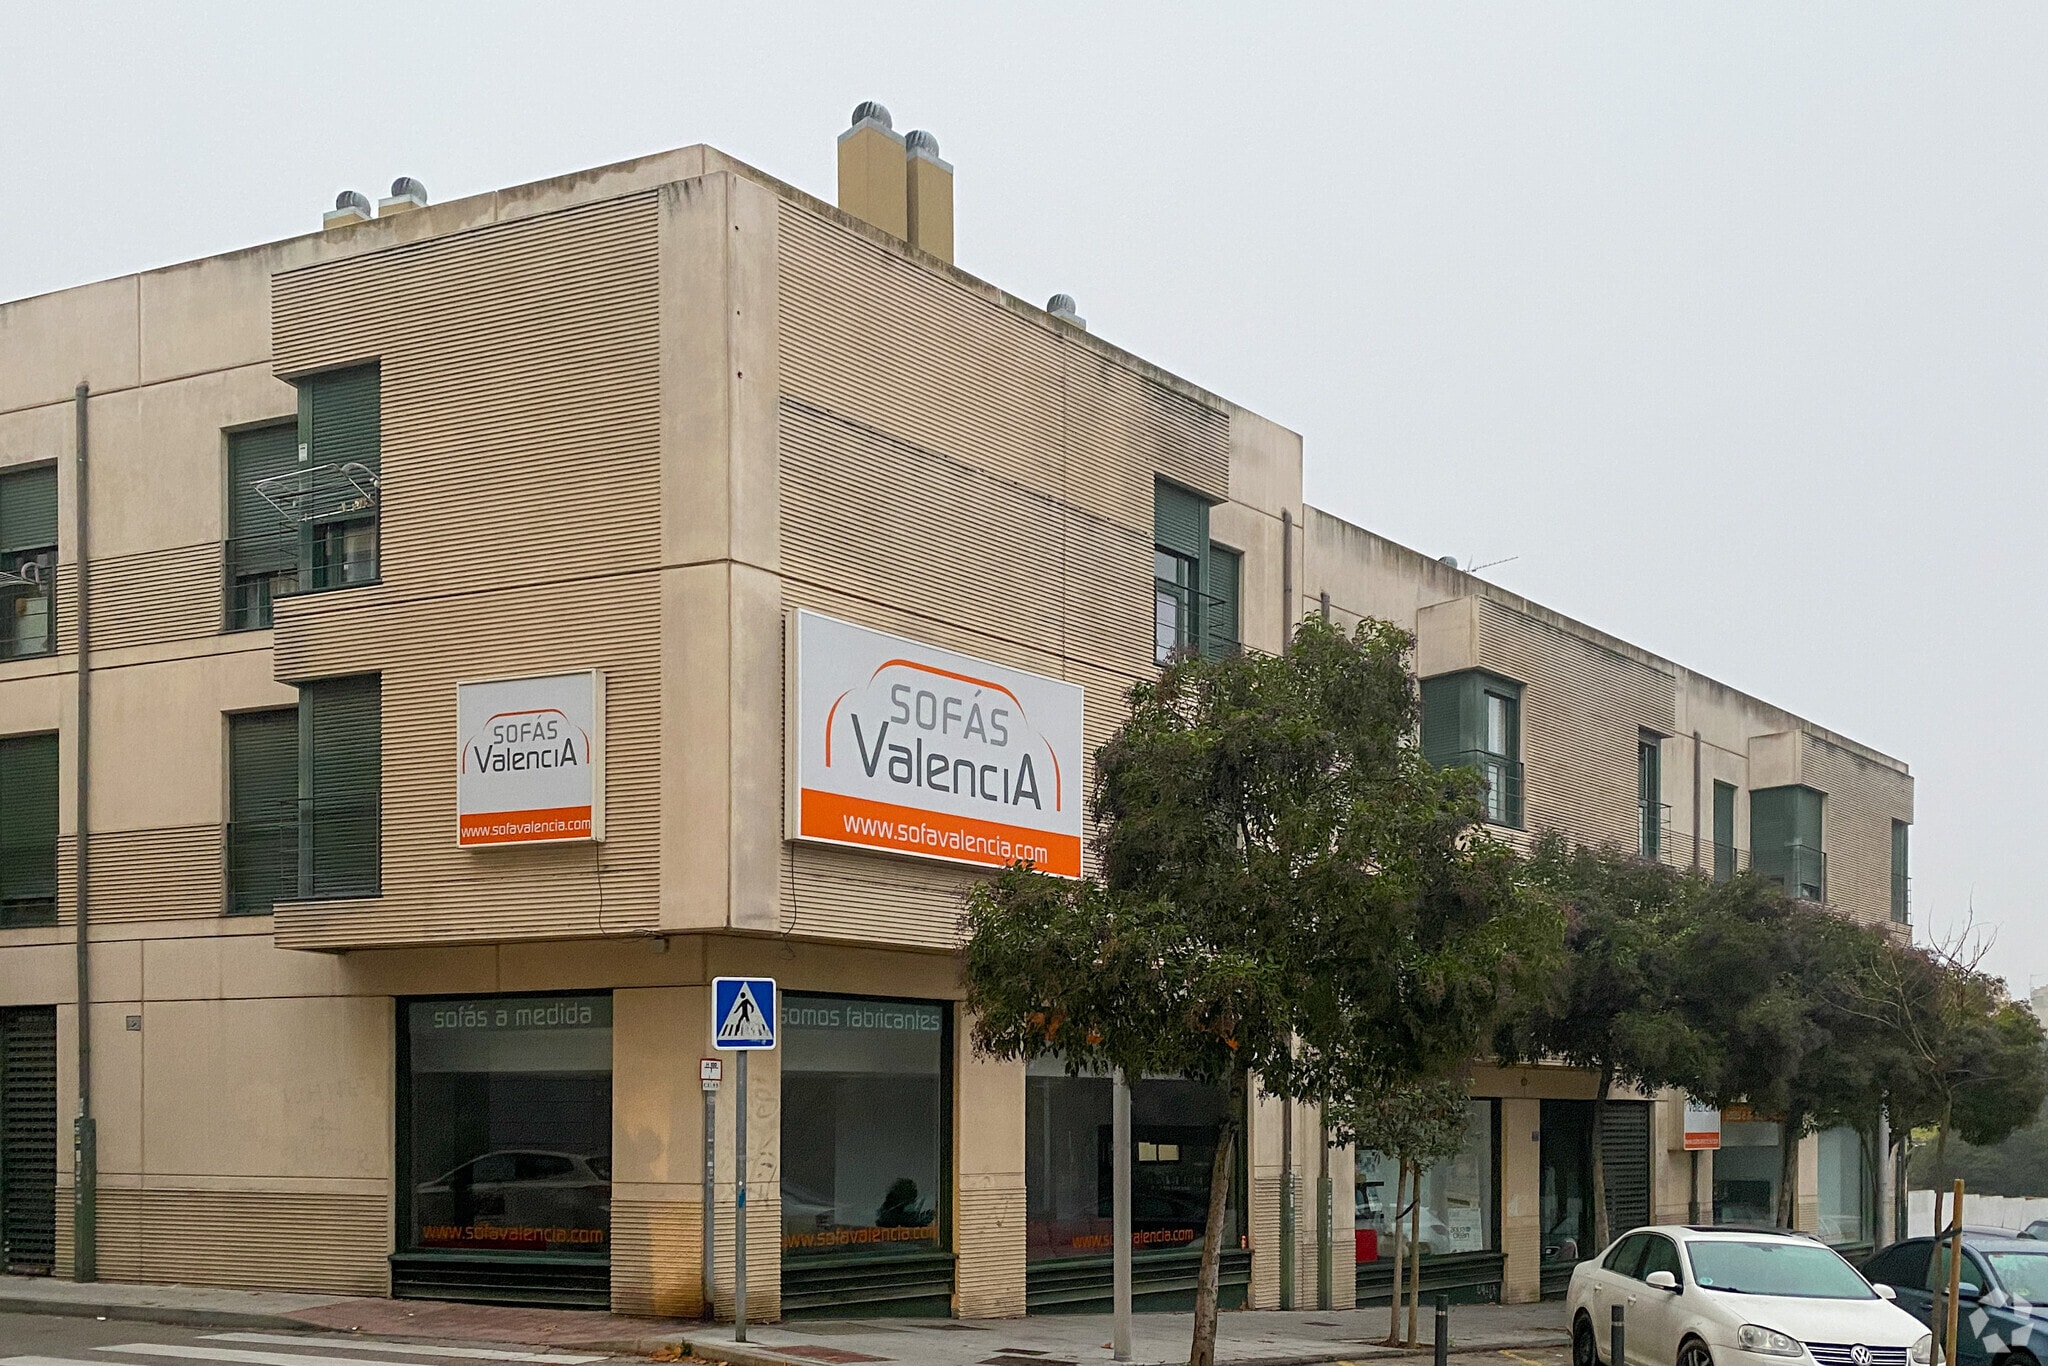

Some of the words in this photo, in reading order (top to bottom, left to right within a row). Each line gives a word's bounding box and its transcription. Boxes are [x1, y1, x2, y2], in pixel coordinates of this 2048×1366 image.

[890, 683, 1009, 748] SOFÁS
[493, 714, 558, 745] SOFÁS
[461, 818, 591, 838] www.sofavalencia.com
[843, 814, 1048, 864] www.sofavalencia.com
[434, 1005, 488, 1029] sofás
[496, 1009, 508, 1027] a
[516, 1002, 592, 1026] medida
[846, 1006, 940, 1031] fabricantes
[422, 1224, 604, 1243] www.sofavalencia.com
